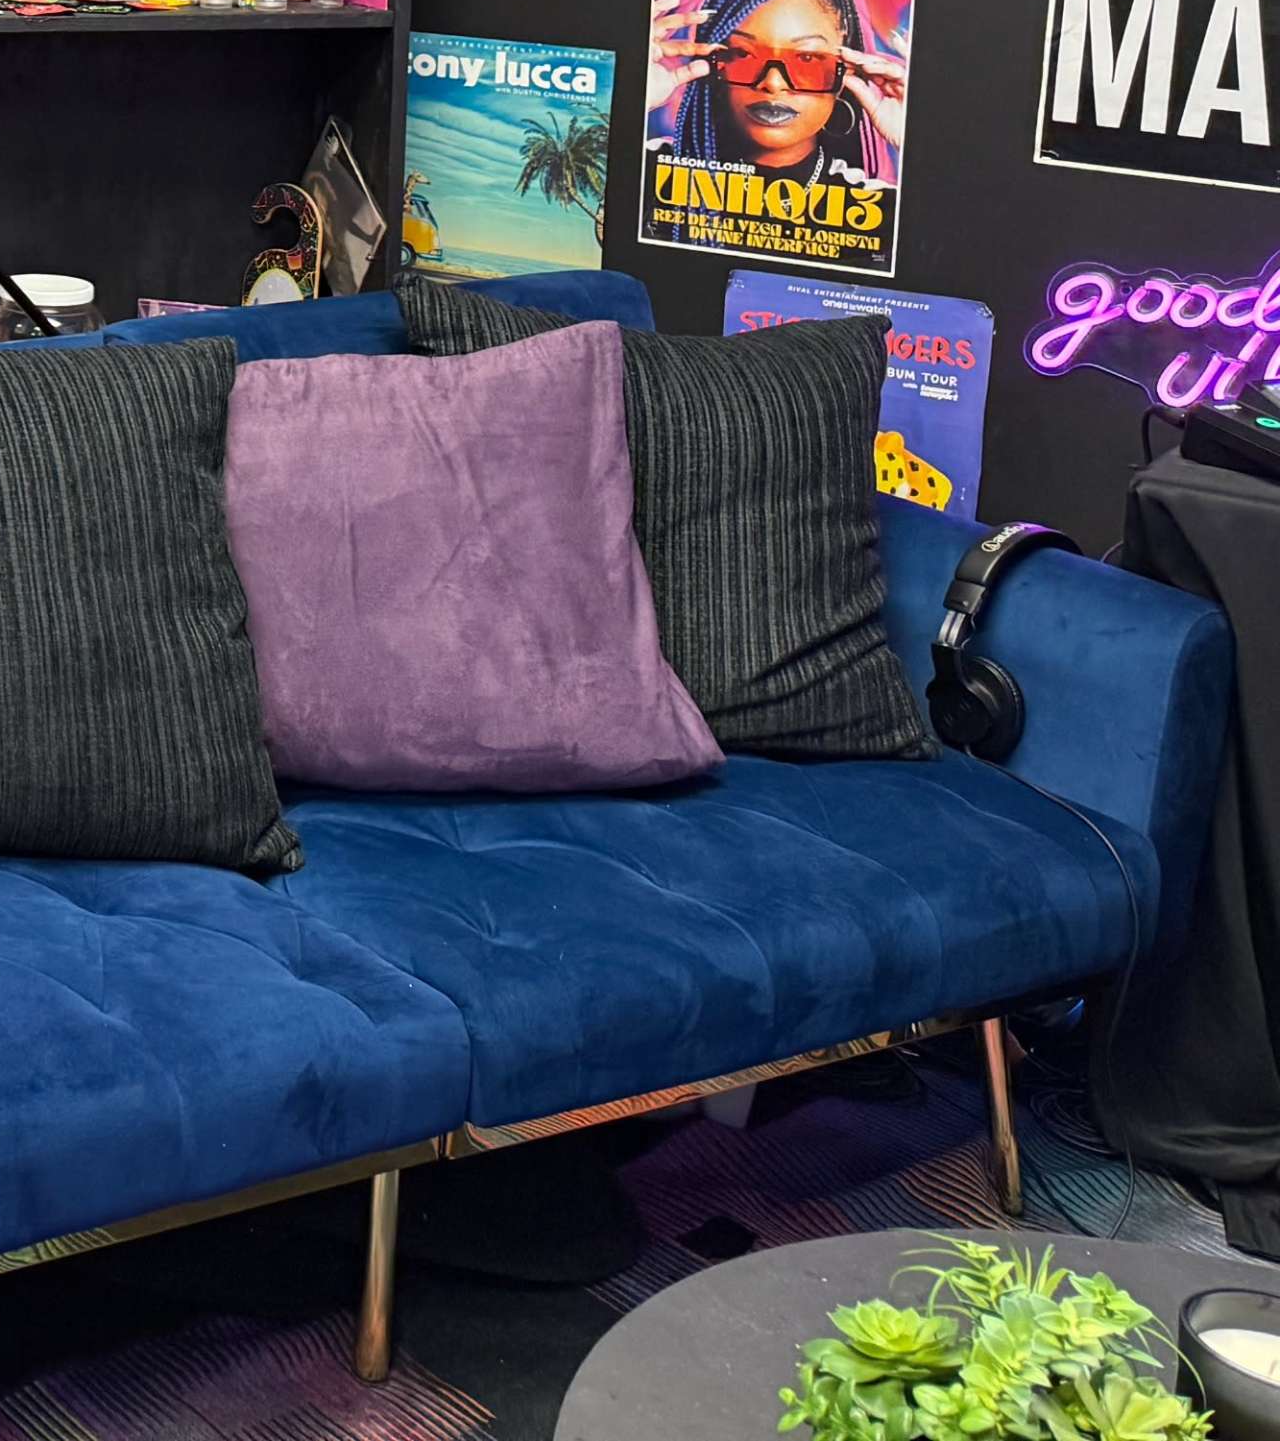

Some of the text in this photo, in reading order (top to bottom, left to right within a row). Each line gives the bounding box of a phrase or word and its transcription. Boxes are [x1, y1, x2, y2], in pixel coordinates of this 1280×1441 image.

[495, 51, 597, 94] lucca
[657, 154, 756, 174] SEASON CLOSER
[794, 227, 881, 251] FLORISTA
[787, 285, 930, 311] RIVAL ENTERTAINMENT PRESENTS
[921, 372, 958, 387] TOUR
